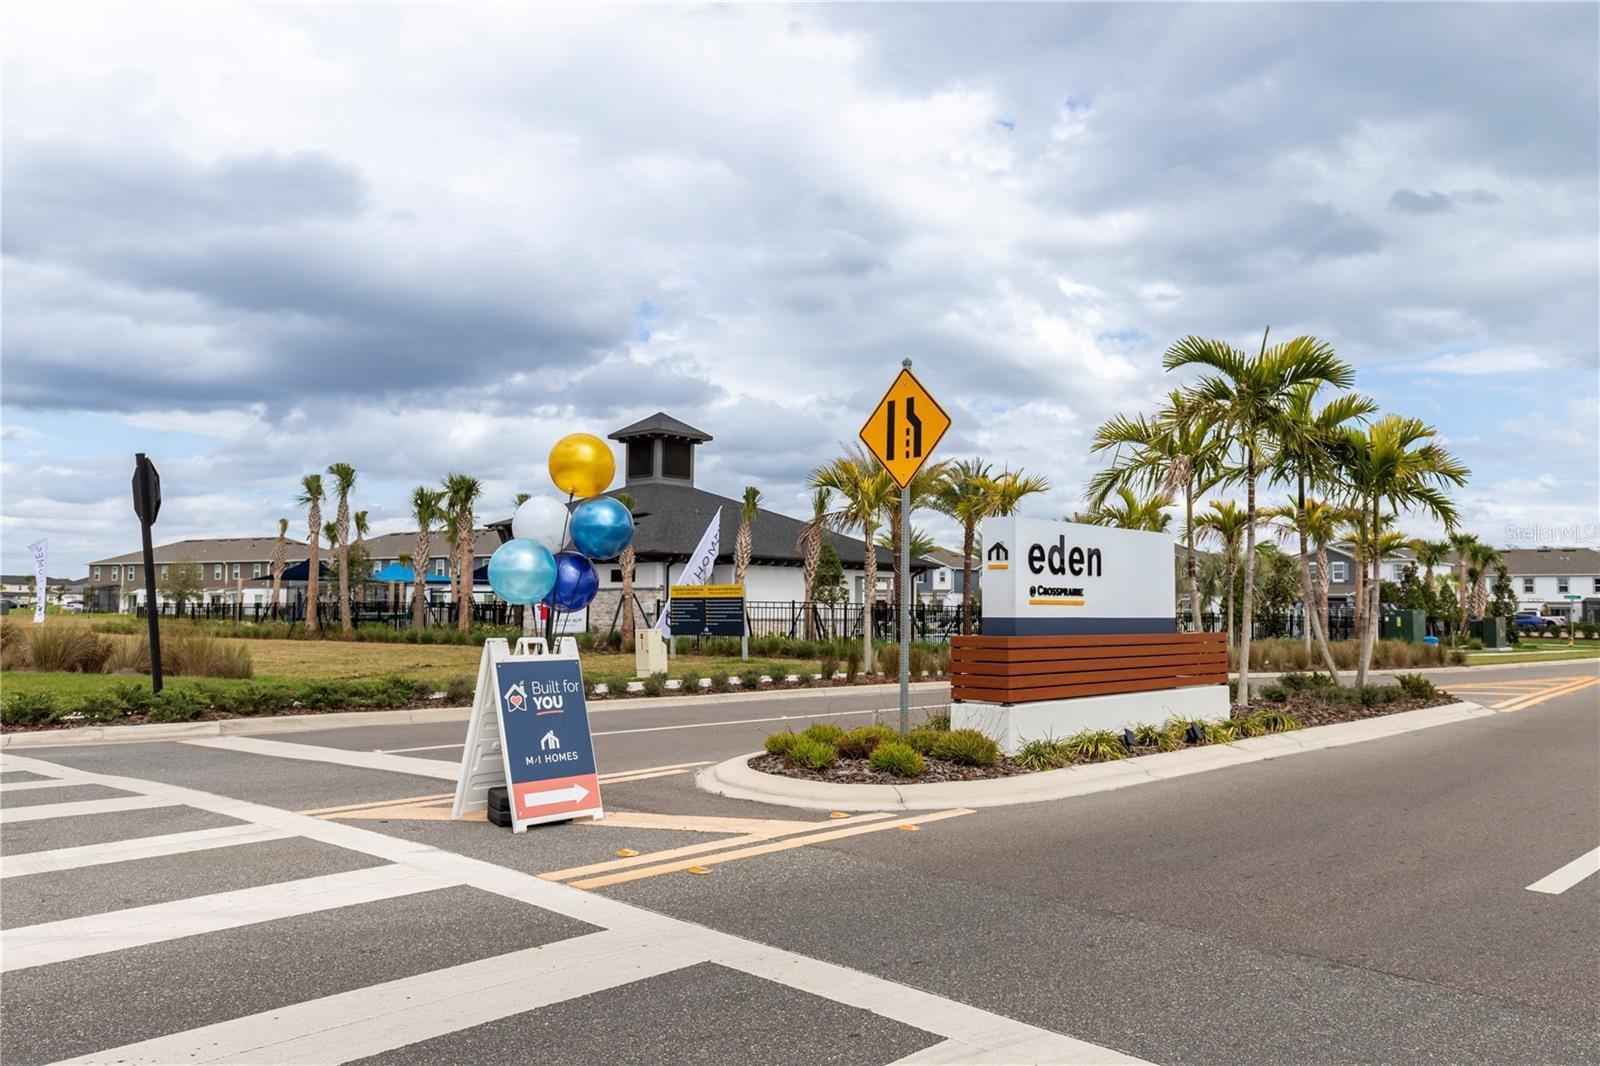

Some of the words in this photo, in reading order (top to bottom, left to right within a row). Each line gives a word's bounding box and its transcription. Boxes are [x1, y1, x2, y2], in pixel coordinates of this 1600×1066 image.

[1028, 534, 1102, 577] eden
[531, 680, 560, 695] Built
[563, 679, 579, 693] for
[533, 695, 563, 710] YOU
[545, 751, 579, 763] HOMES
